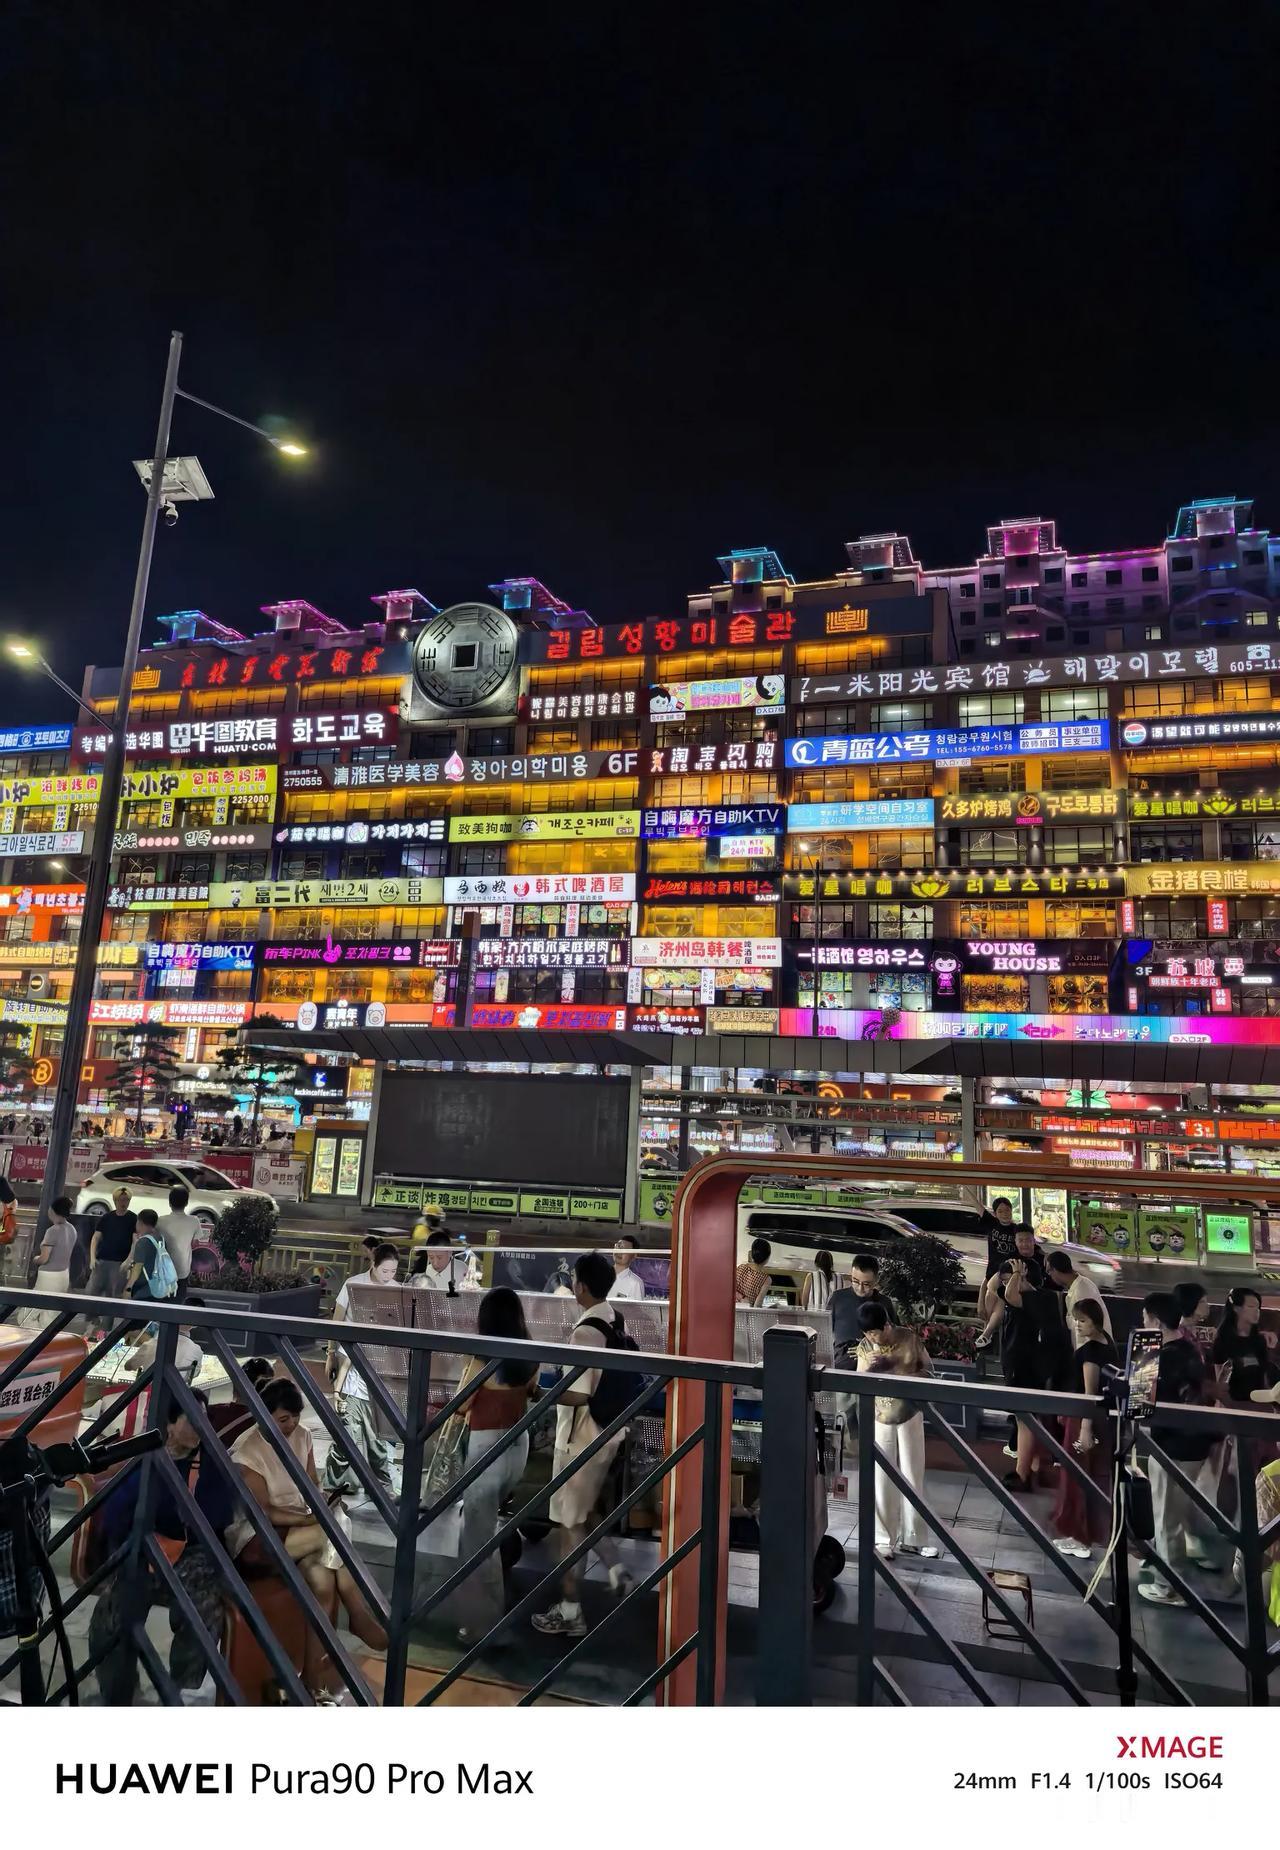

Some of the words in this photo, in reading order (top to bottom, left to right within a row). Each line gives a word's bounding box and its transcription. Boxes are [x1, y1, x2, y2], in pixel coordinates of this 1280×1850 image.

[1064, 647, 1219, 682] 해맞이모텔
[814, 663, 1010, 696] 一米阳光宾馆
[191, 718, 278, 752] 华图教育
[292, 713, 386, 743] 화도교육
[936, 730, 1013, 745] 청람공무원시험
[671, 743, 775, 763] 淘宝闪购
[822, 735, 932, 761] 青蓝公考
[470, 755, 589, 781] 청아의학미용
[608, 753, 638, 774] 6F
[284, 776, 322, 787] 2750555
[334, 763, 439, 786] 清雅医学美容
[942, 799, 1012, 818] 久多炉烤鸡
[1047, 794, 1118, 818] 구도로통닭
[547, 817, 614, 836] 개조은카페
[185, 830, 211, 847] 민족
[383, 885, 395, 894] 24
[536, 876, 624, 893] 韩式啤酒屋
[800, 879, 892, 896] 爱星唱咖
[967, 877, 1069, 894] 러브스타
[659, 941, 744, 958] 济州岛韩餐
[857, 948, 925, 966] 영하우스
[967, 942, 1037, 956] YOUNG
[993, 957, 1062, 971] HOUSE
[1135, 966, 1153, 976] 3F
[573, 1200, 608, 1210] 200+门店
